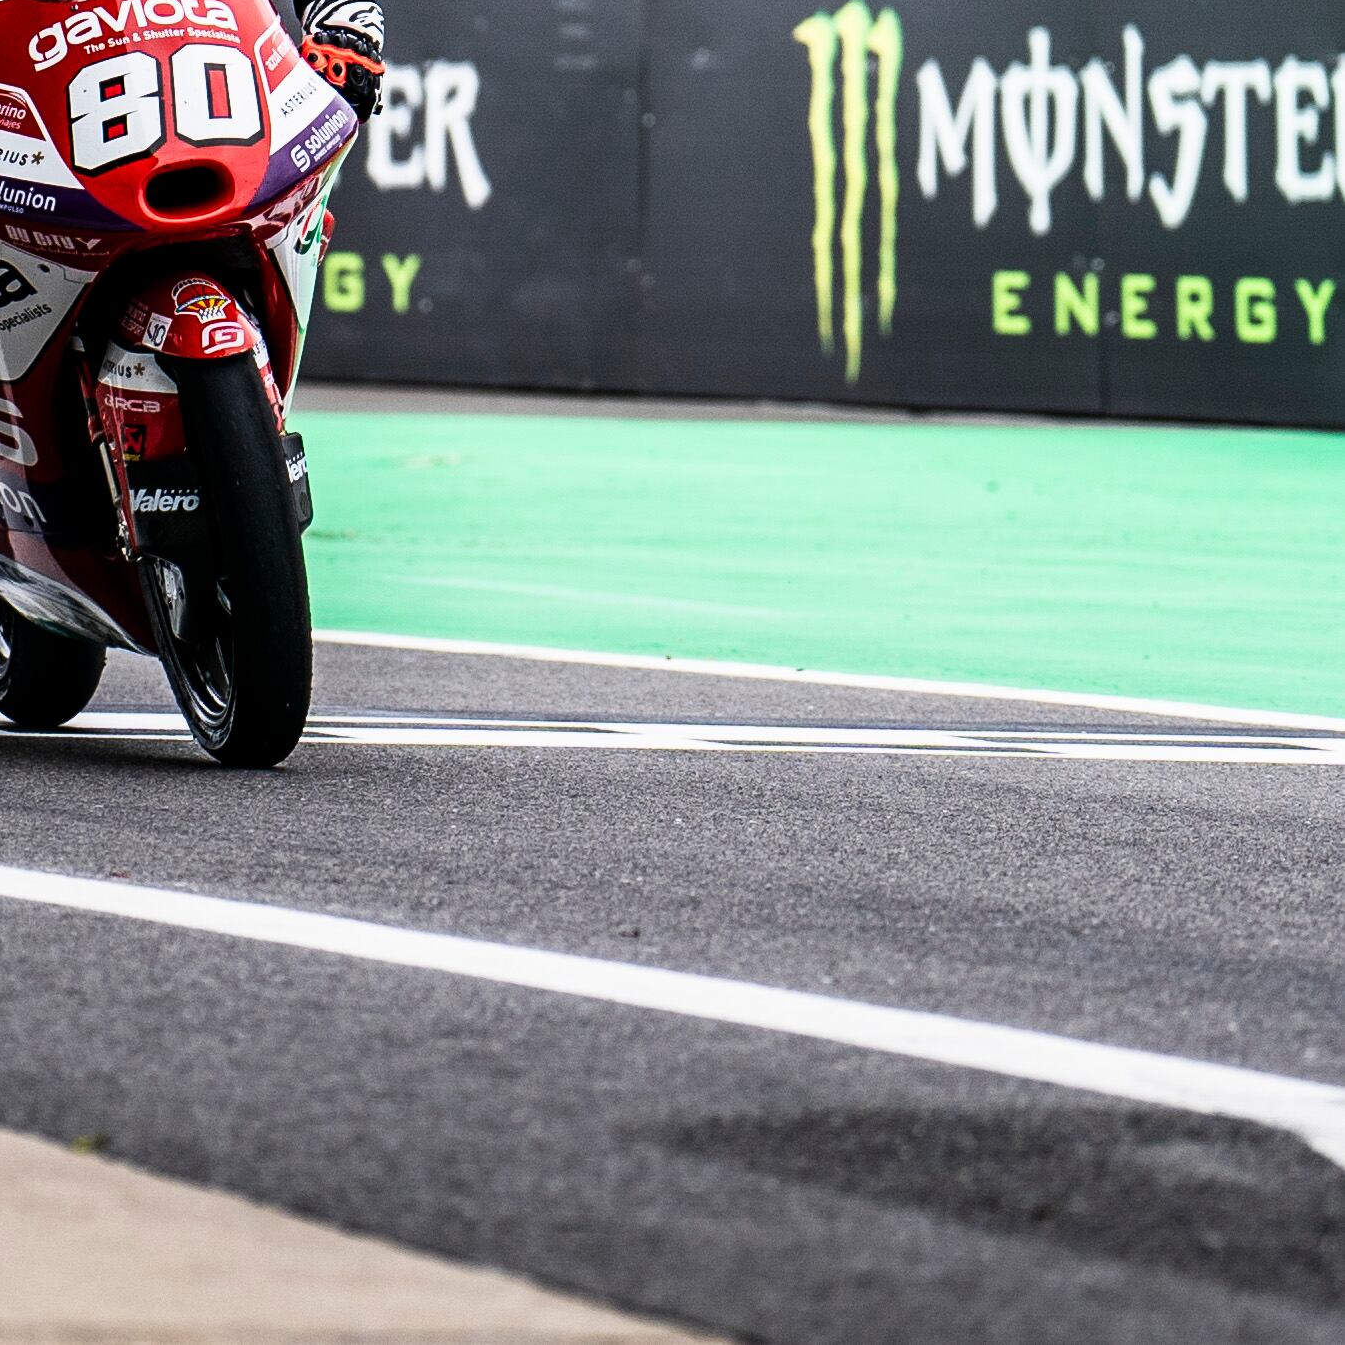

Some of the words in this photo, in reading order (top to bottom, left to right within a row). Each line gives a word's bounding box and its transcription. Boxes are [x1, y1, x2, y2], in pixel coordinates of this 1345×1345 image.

[83, 42, 106, 55] The
[107, 36, 130, 49] Sun
[132, 31, 142, 43] &
[143, 27, 186, 42] Shutter
[68, 43, 264, 177] 80
[305, 109, 349, 155] solunion
[991, 270, 1337, 345] ENERGY
[129, 488, 200, 512] Valero
